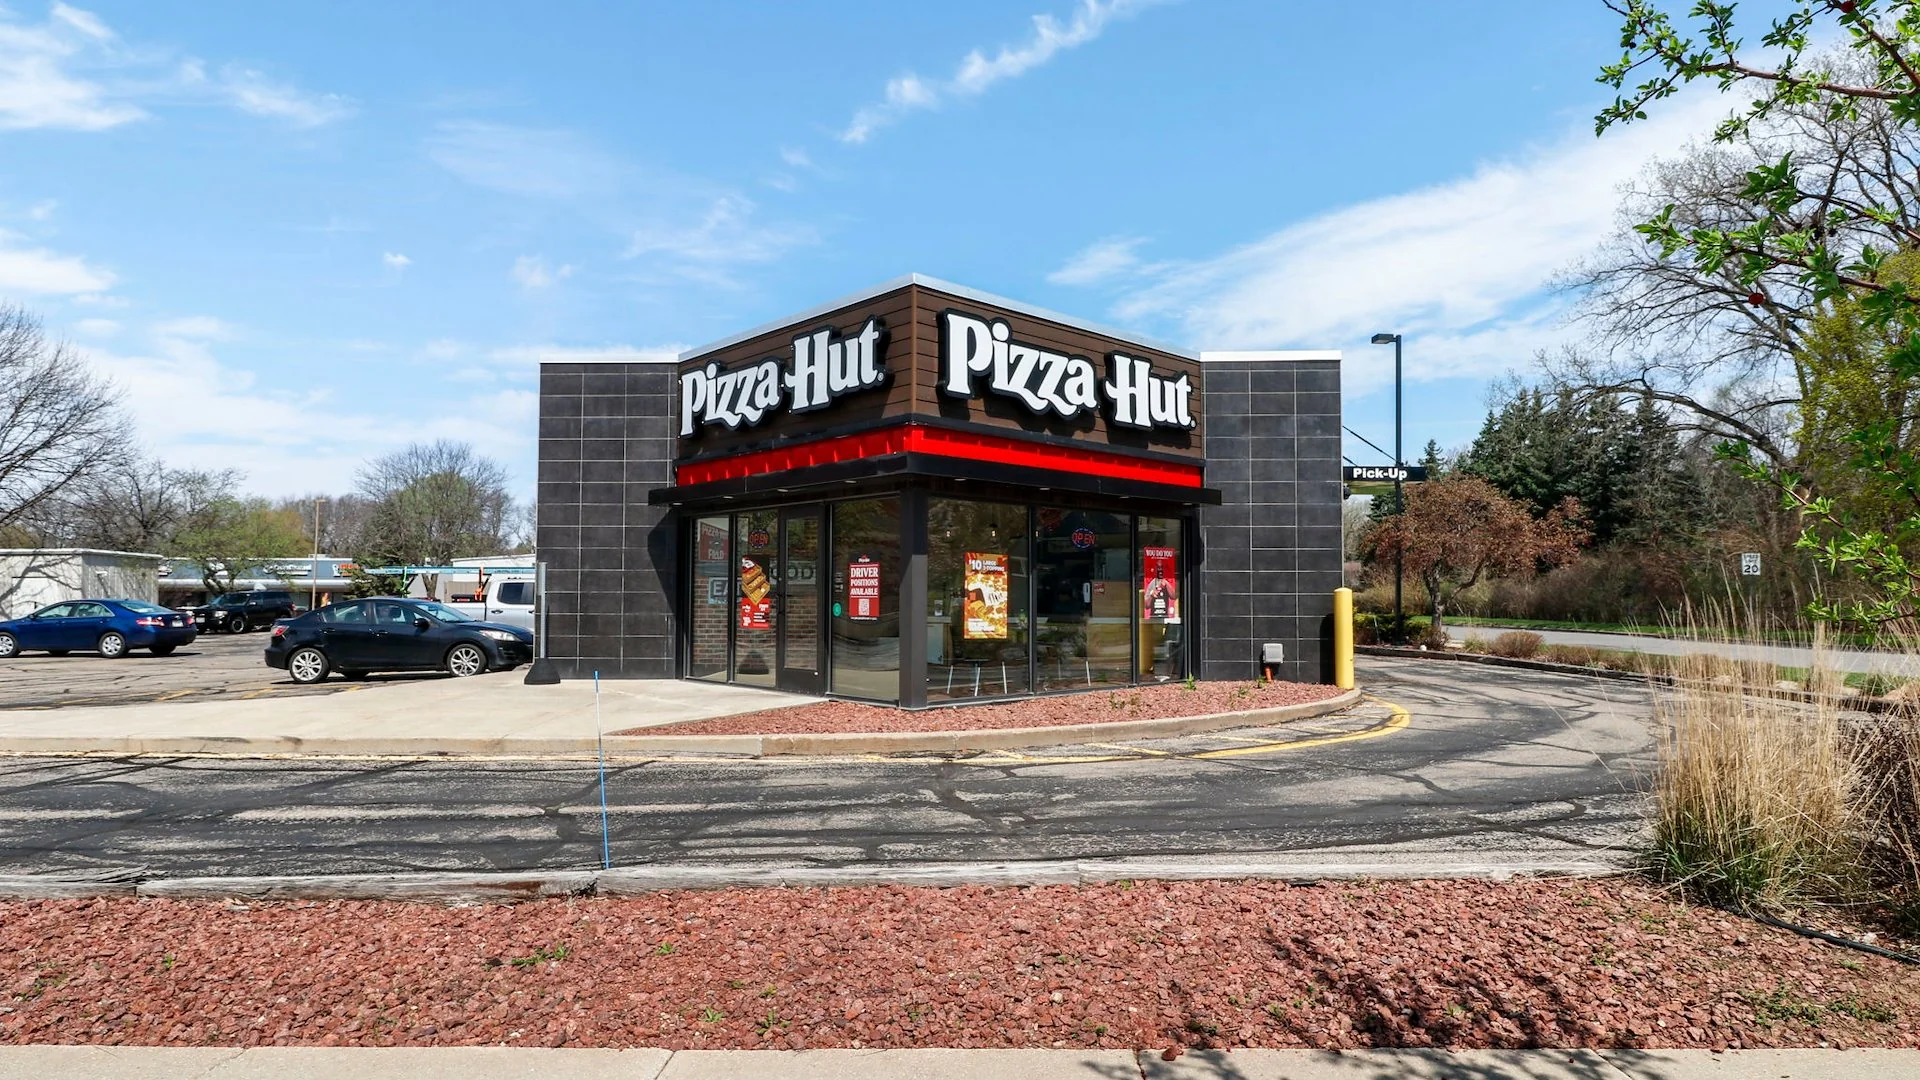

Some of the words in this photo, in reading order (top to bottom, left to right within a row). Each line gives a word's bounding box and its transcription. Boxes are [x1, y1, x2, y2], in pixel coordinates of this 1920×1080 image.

[680, 361, 780, 436] Pizza
[784, 316, 882, 410] Hut
[946, 313, 1097, 415] Pizza
[1105, 353, 1195, 428] Hut
[1353, 468, 1407, 480] Pick-Up
[1072, 533, 1095, 544] OPEN
[850, 567, 878, 578] DRIVER
[1744, 565, 1759, 573] 20
[850, 578, 878, 587] POSITIONS
[850, 587, 878, 596] AVAILABLE
